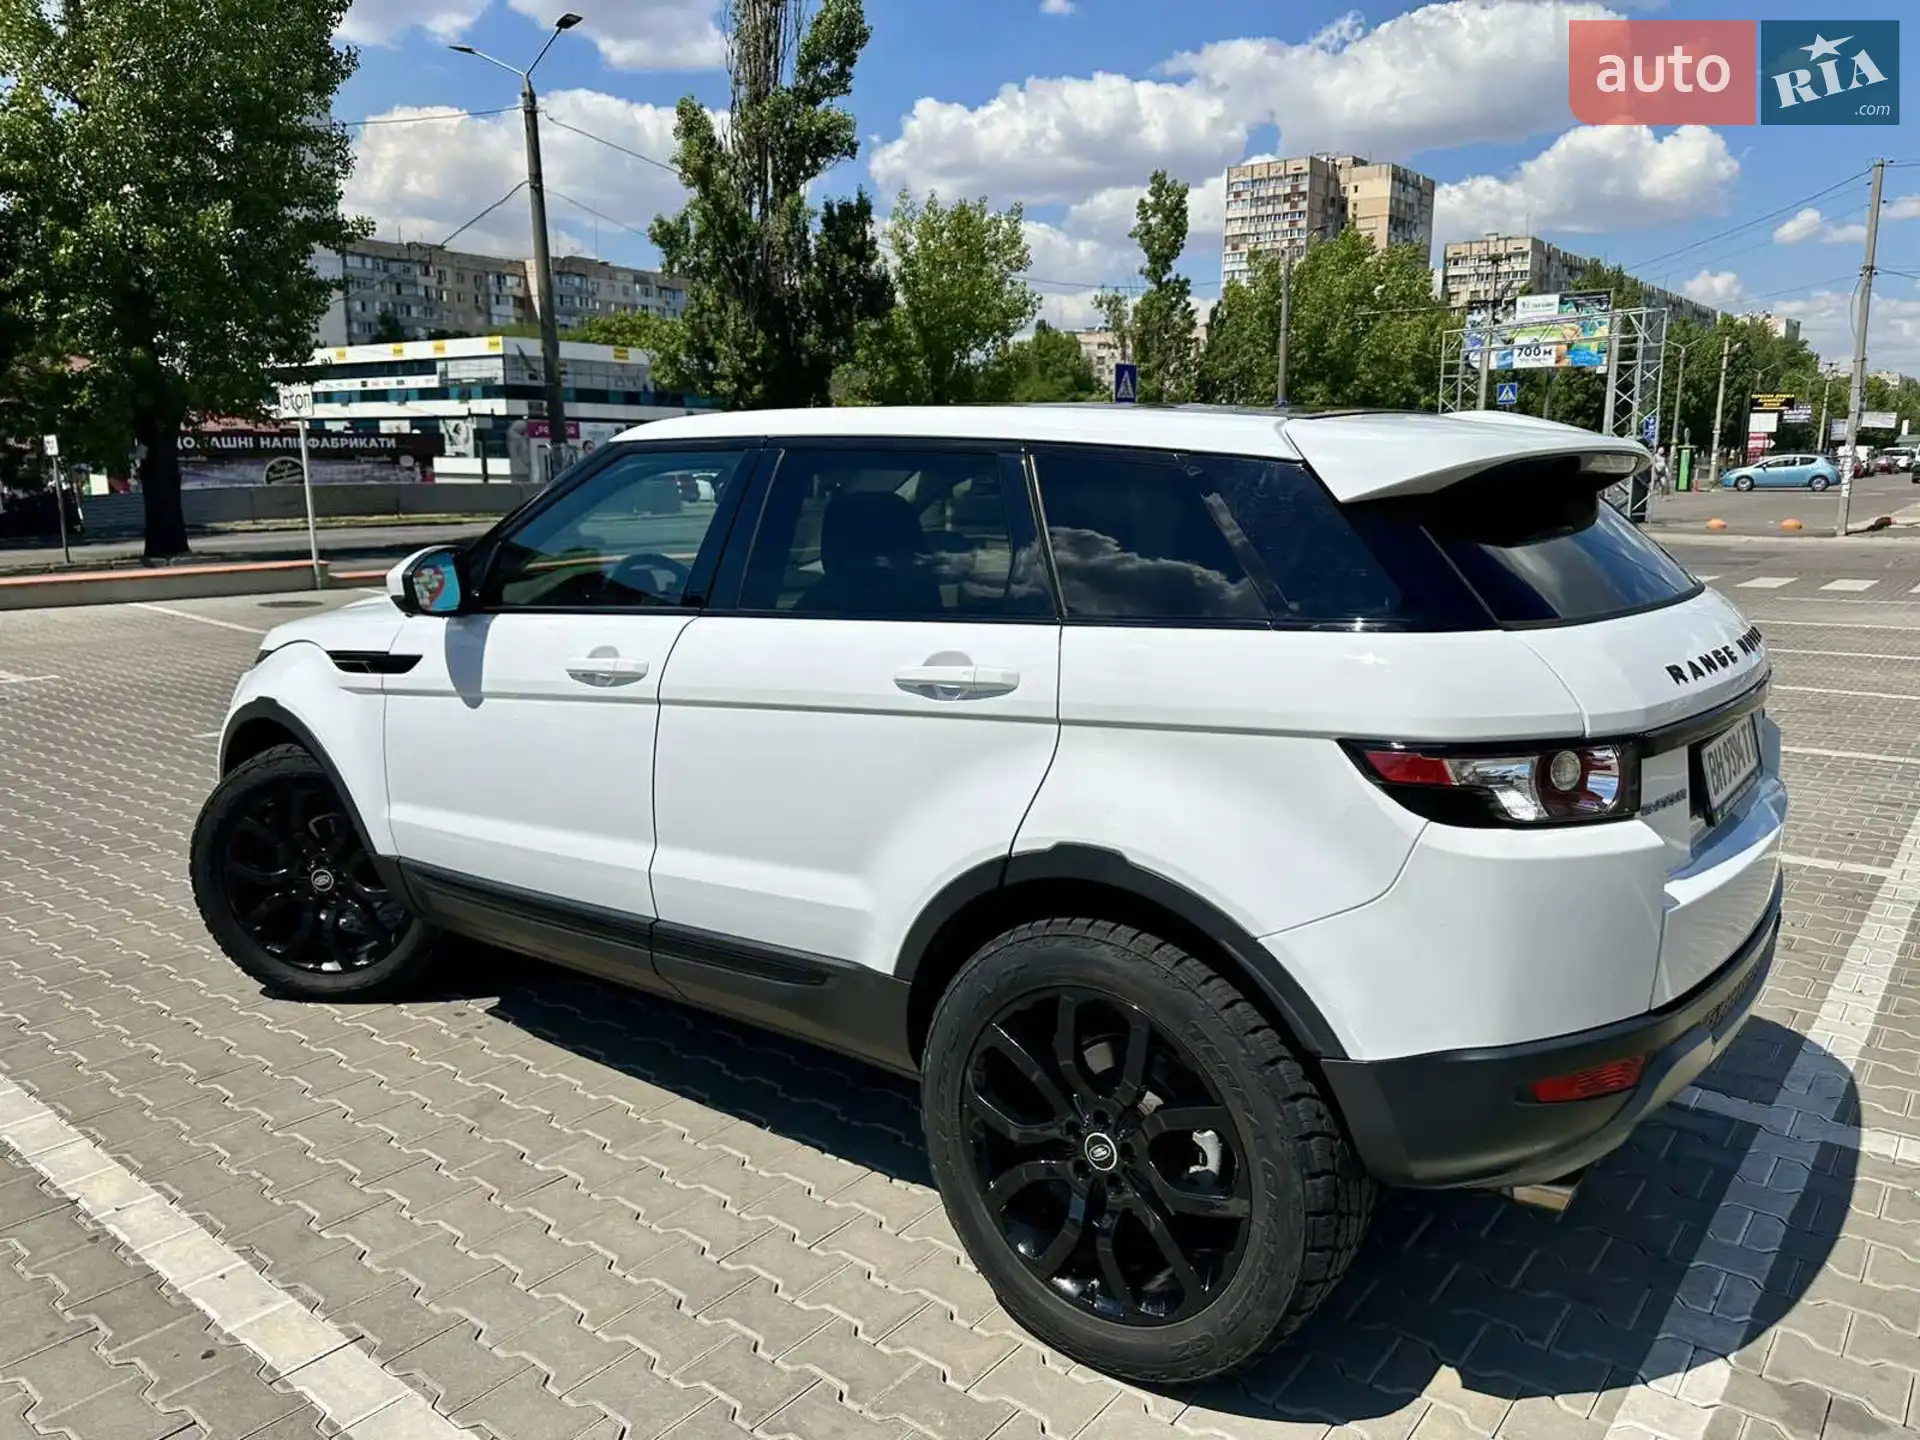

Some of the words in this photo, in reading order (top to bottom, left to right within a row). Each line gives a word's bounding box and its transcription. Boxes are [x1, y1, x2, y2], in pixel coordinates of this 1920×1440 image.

[1517, 346, 1541, 358] 700
[176, 436, 254, 450] ОАШНІ
[260, 437, 397, 449] НАПІФАБРИКАТИ
[1665, 645, 1739, 686] RANGE
